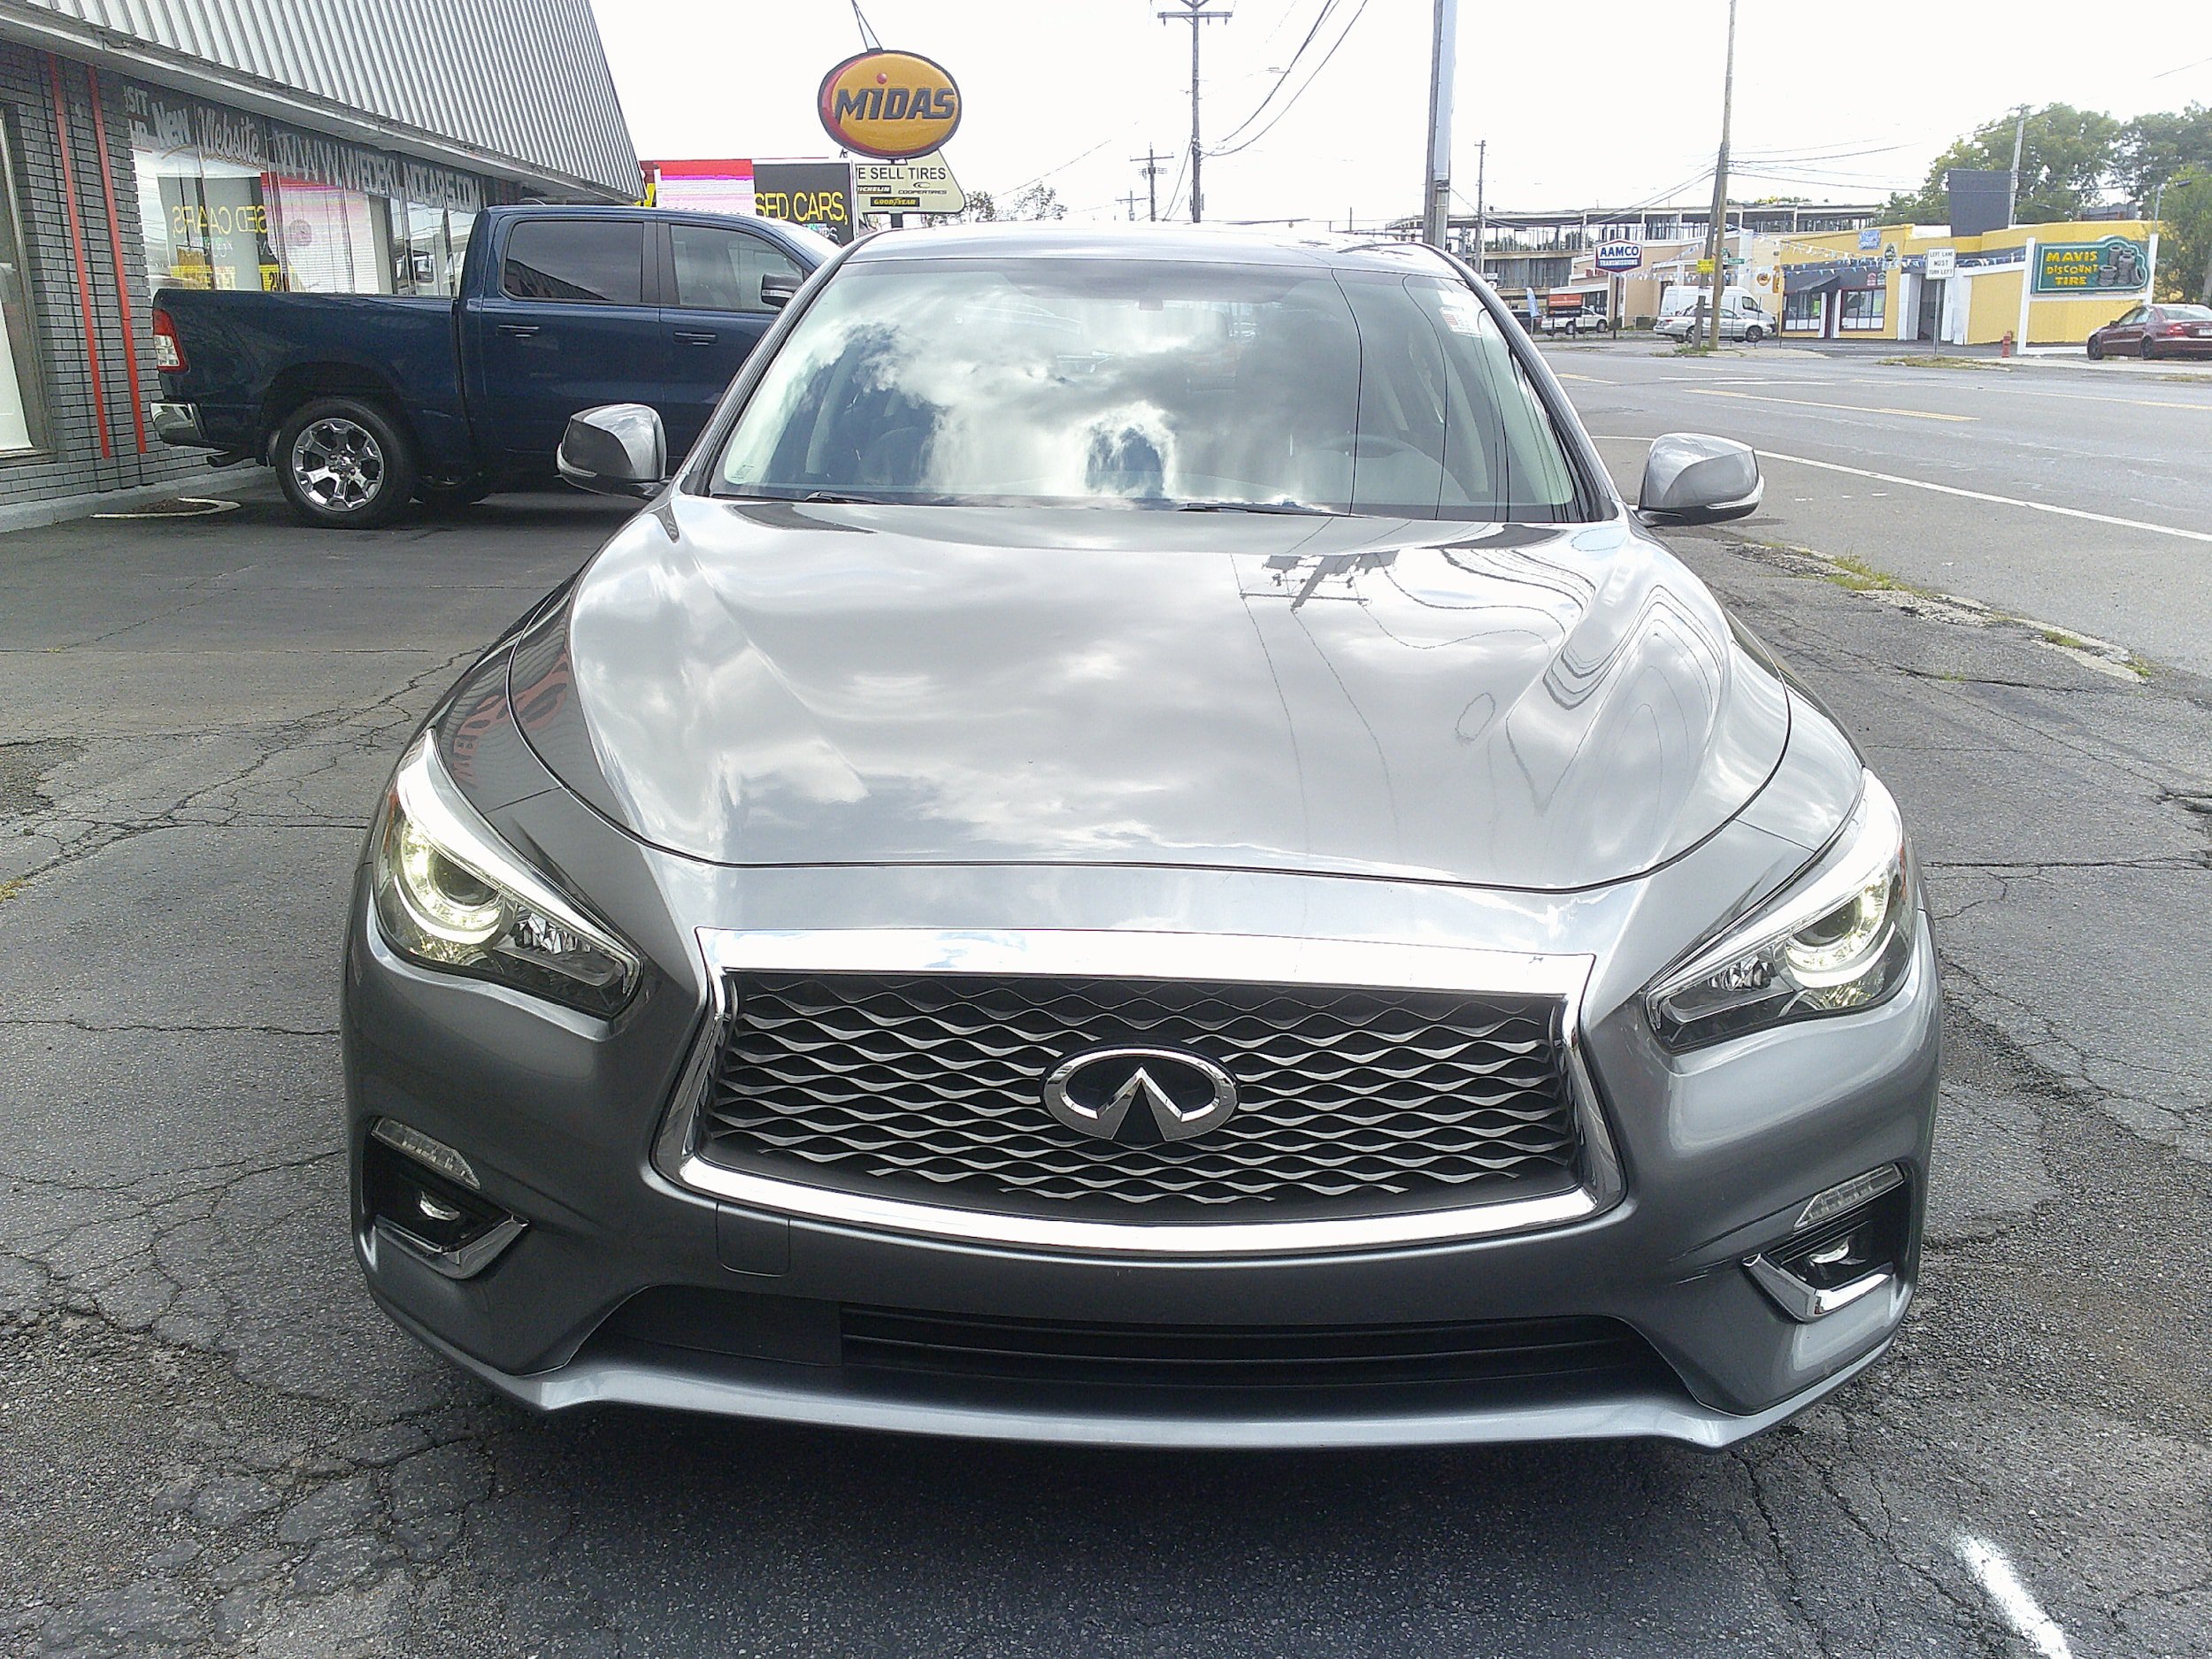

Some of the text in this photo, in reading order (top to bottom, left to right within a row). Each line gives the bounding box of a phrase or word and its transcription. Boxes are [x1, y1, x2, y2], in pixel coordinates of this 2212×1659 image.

[834, 87, 956, 124] MIDAS
[870, 167, 904, 180] SELL
[908, 167, 947, 180] TIRES
[1600, 246, 1639, 257] AAMCO
[2046, 251, 2098, 262] MAVIS
[2047, 264, 2099, 274] DISCOUNT
[2055, 276, 2087, 286] TIRE
